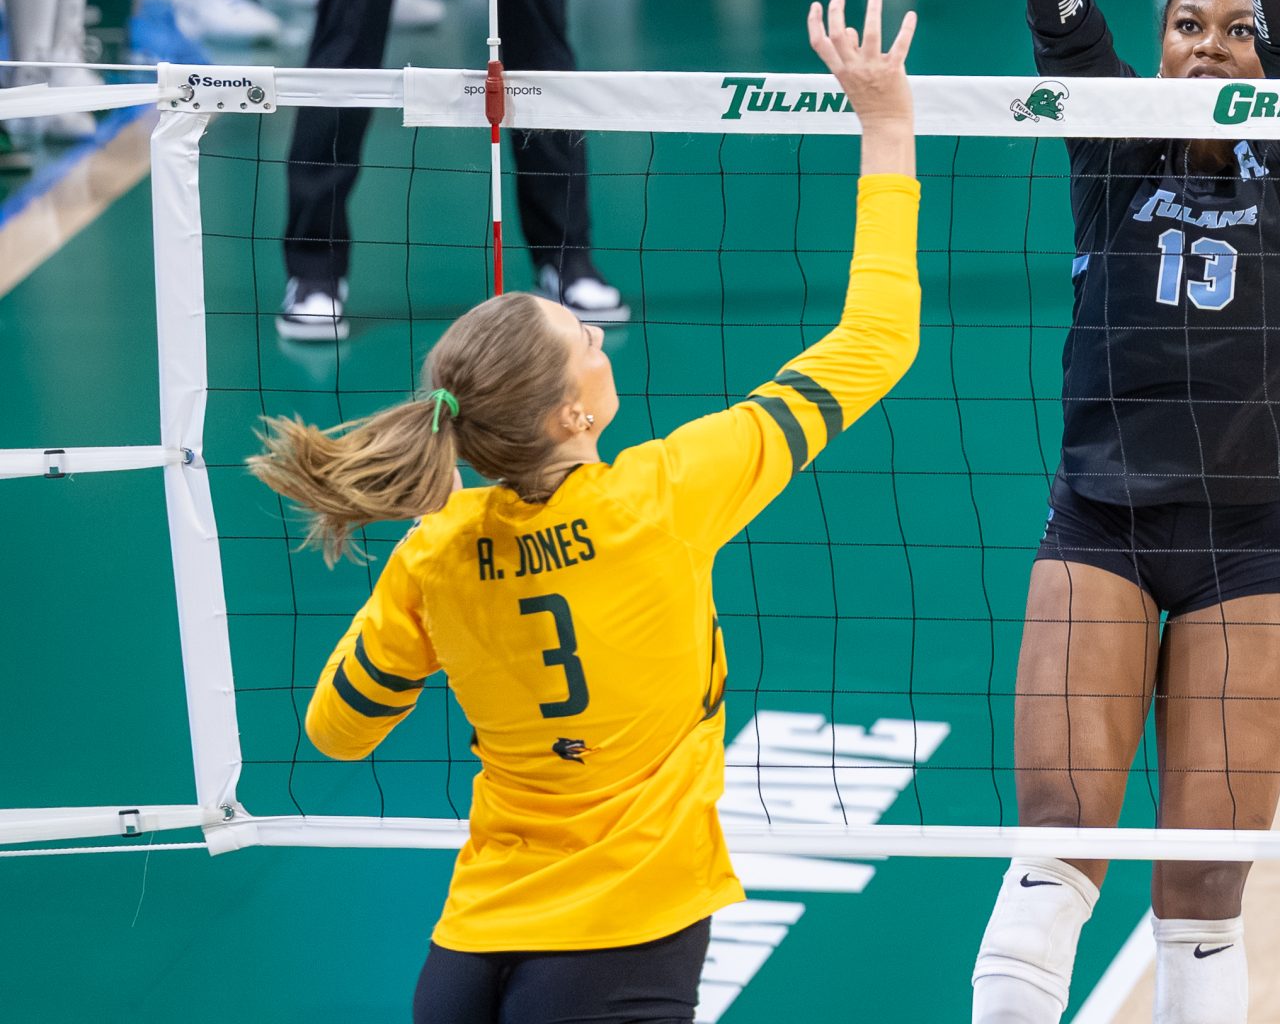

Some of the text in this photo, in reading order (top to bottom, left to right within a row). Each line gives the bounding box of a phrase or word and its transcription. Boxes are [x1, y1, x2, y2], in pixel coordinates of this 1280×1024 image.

[202, 77, 252, 88] Senoh
[1132, 188, 1259, 229] TULANE
[1155, 228, 1238, 311] 13
[476, 517, 596, 581] A. JONES
[518, 592, 590, 719] 3
